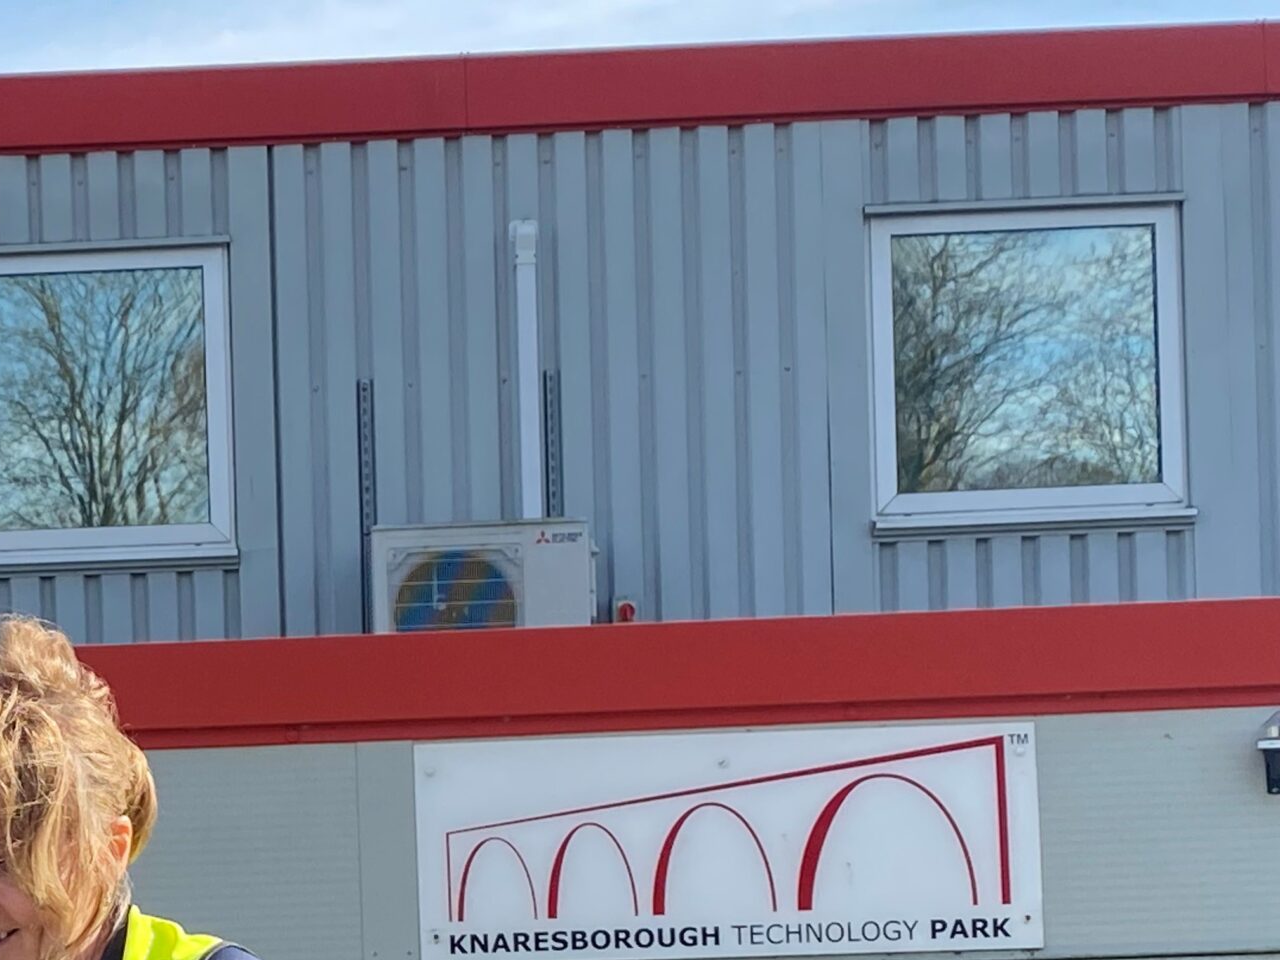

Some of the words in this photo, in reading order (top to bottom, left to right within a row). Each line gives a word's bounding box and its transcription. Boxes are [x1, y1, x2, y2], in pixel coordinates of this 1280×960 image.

[1008, 733, 1029, 744] TM
[449, 926, 720, 955] KNARESBOROUGH
[730, 920, 918, 945] TECHNOLOGY
[930, 917, 1012, 939] PARK
